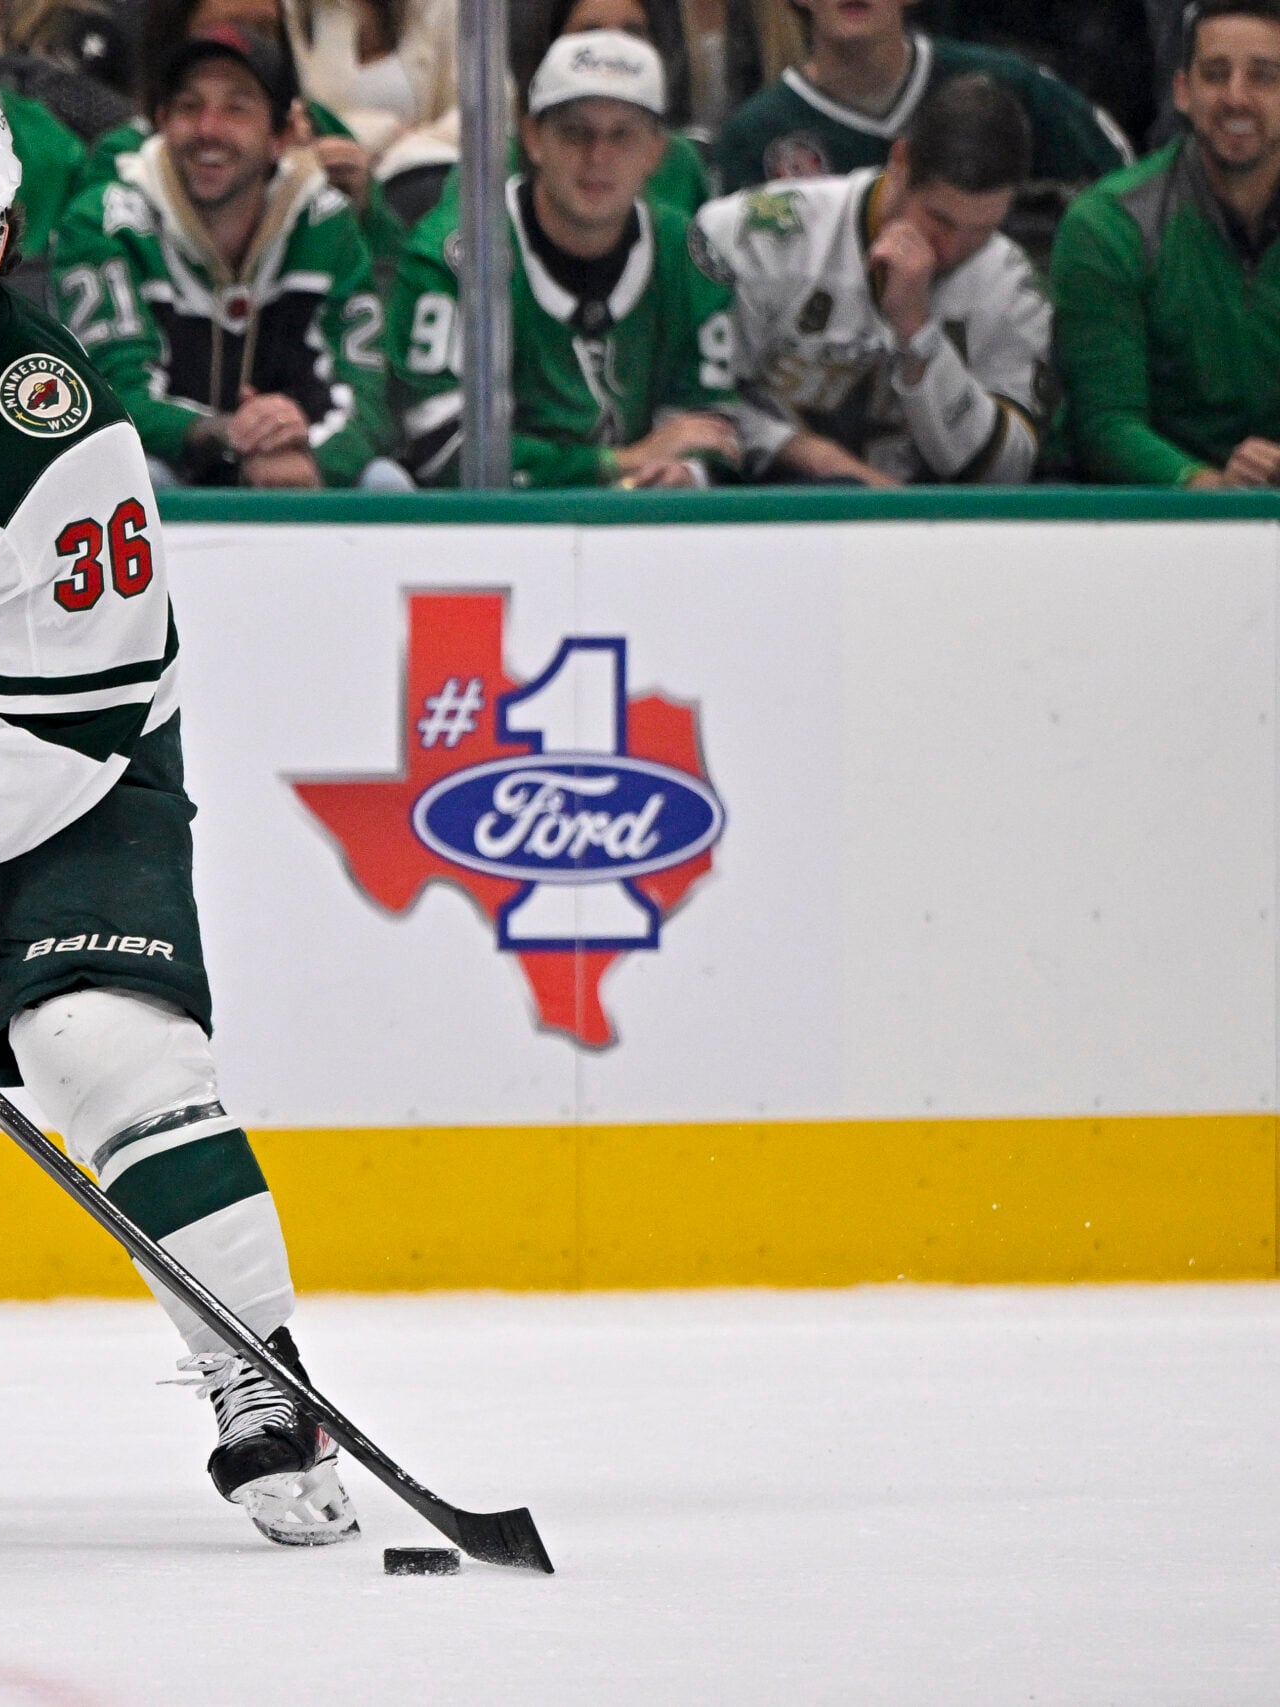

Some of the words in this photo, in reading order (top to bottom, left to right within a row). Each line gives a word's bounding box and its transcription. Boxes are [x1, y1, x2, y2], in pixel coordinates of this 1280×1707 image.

[61, 259, 143, 345] 21
[4, 360, 65, 409] MINNESOTA
[48, 407, 82, 431] WILD
[54, 497, 153, 612] 36
[474, 771, 665, 860] Ford
[23, 933, 174, 961] BAUER
